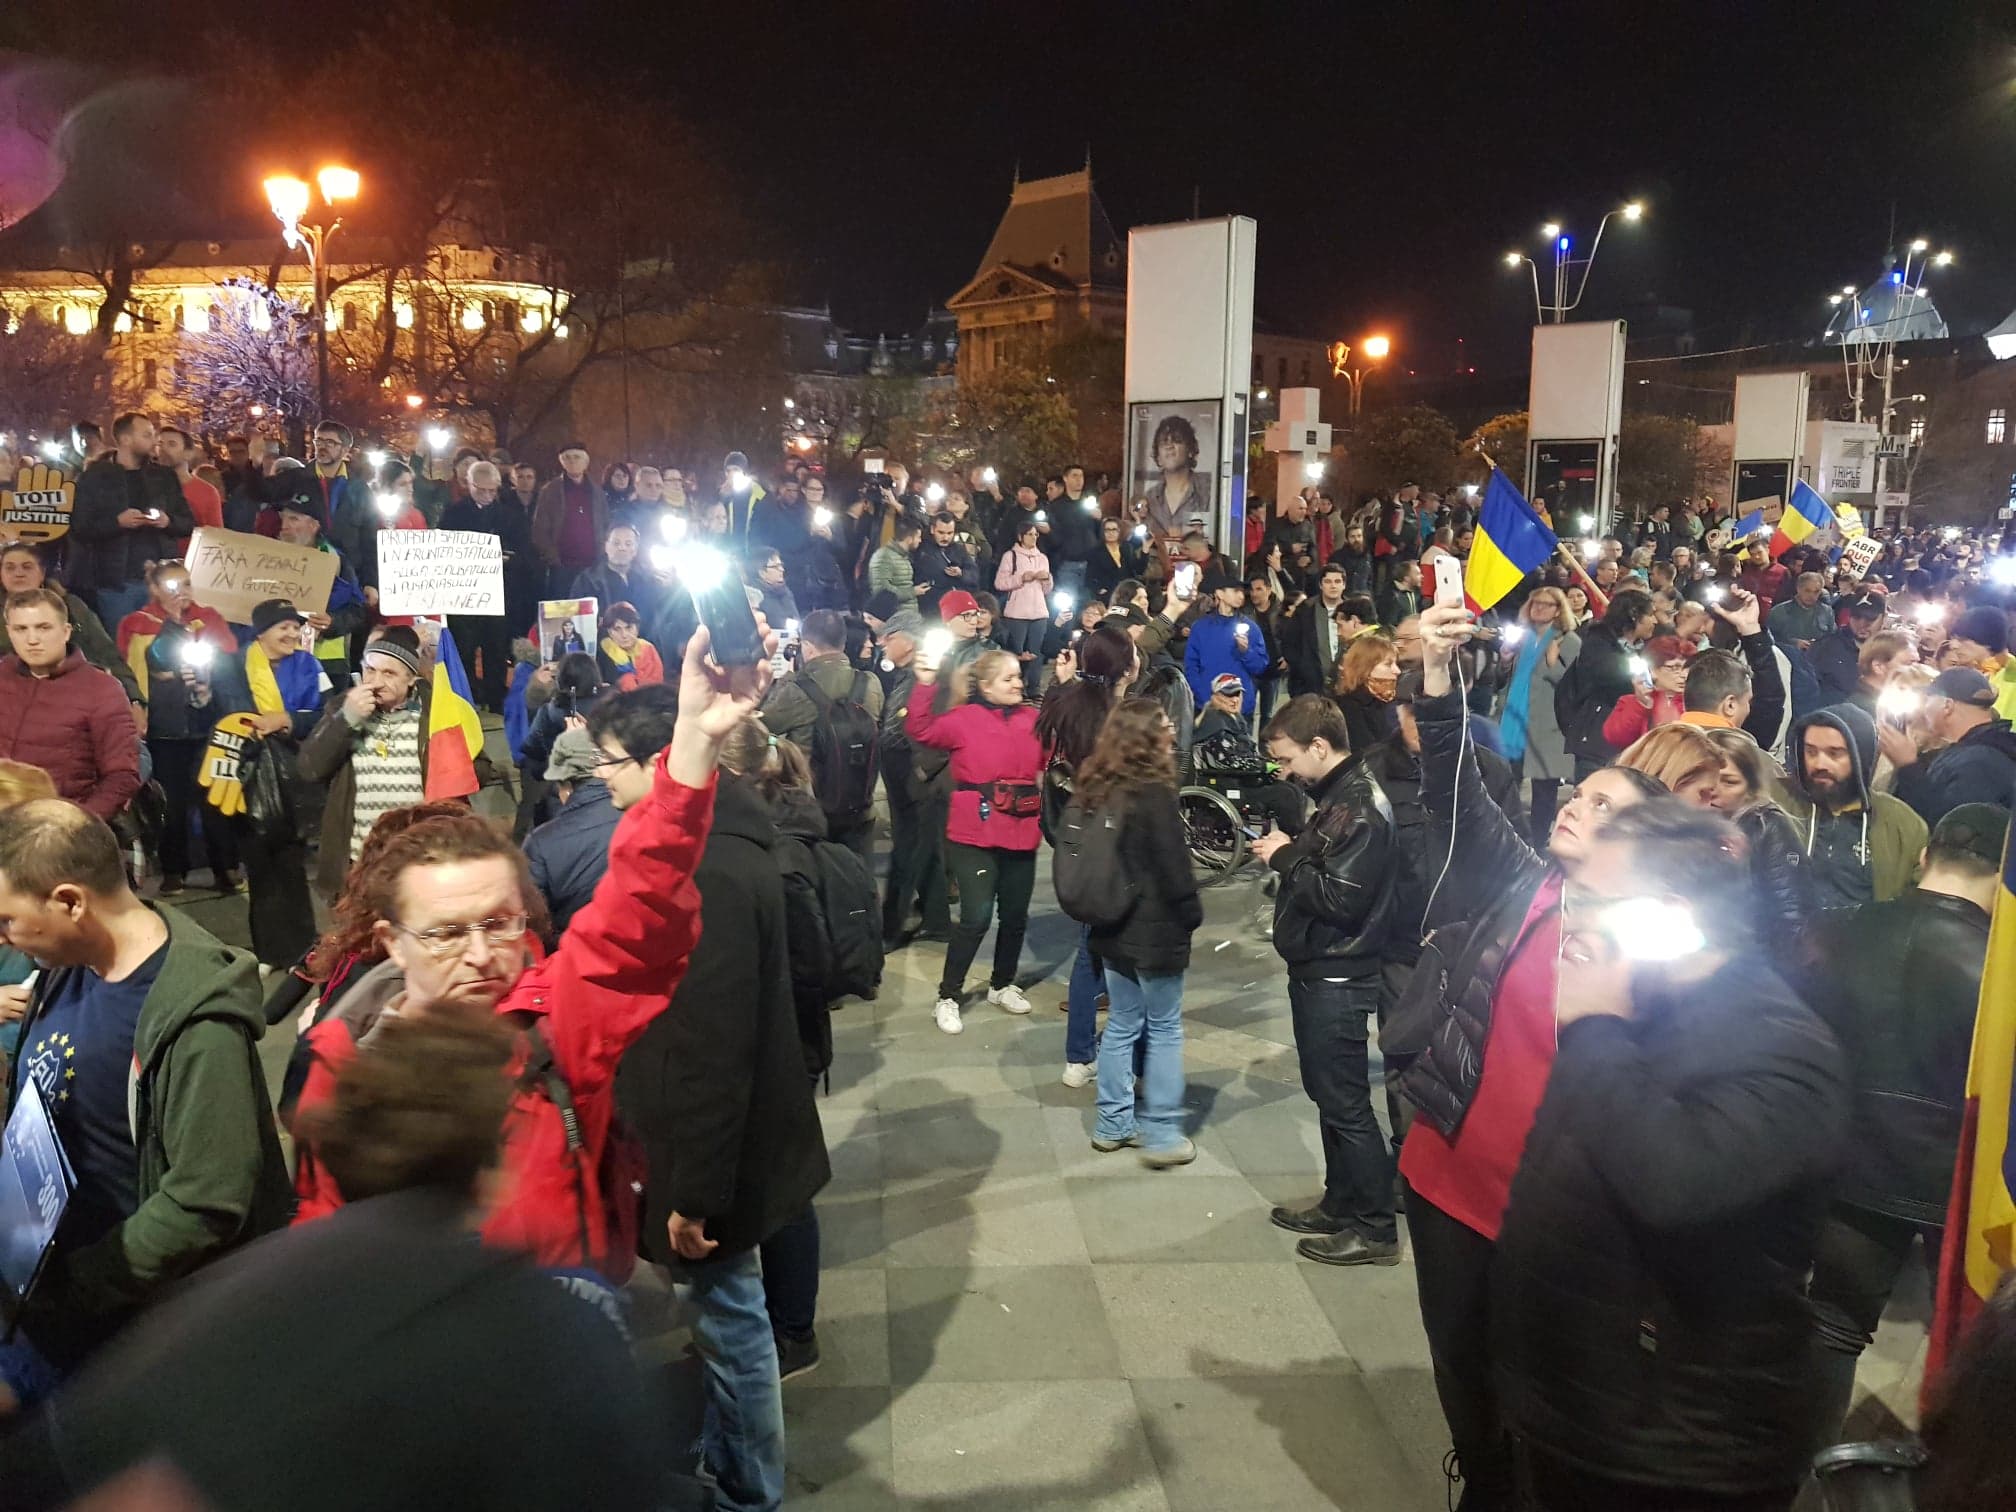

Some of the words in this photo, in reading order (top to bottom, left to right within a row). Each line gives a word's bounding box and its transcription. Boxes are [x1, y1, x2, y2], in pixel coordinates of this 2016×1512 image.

[1833, 465, 1861, 479] TRIPLE
[1832, 479, 1860, 488] FRONTIER
[1852, 540, 1876, 555] ABR
